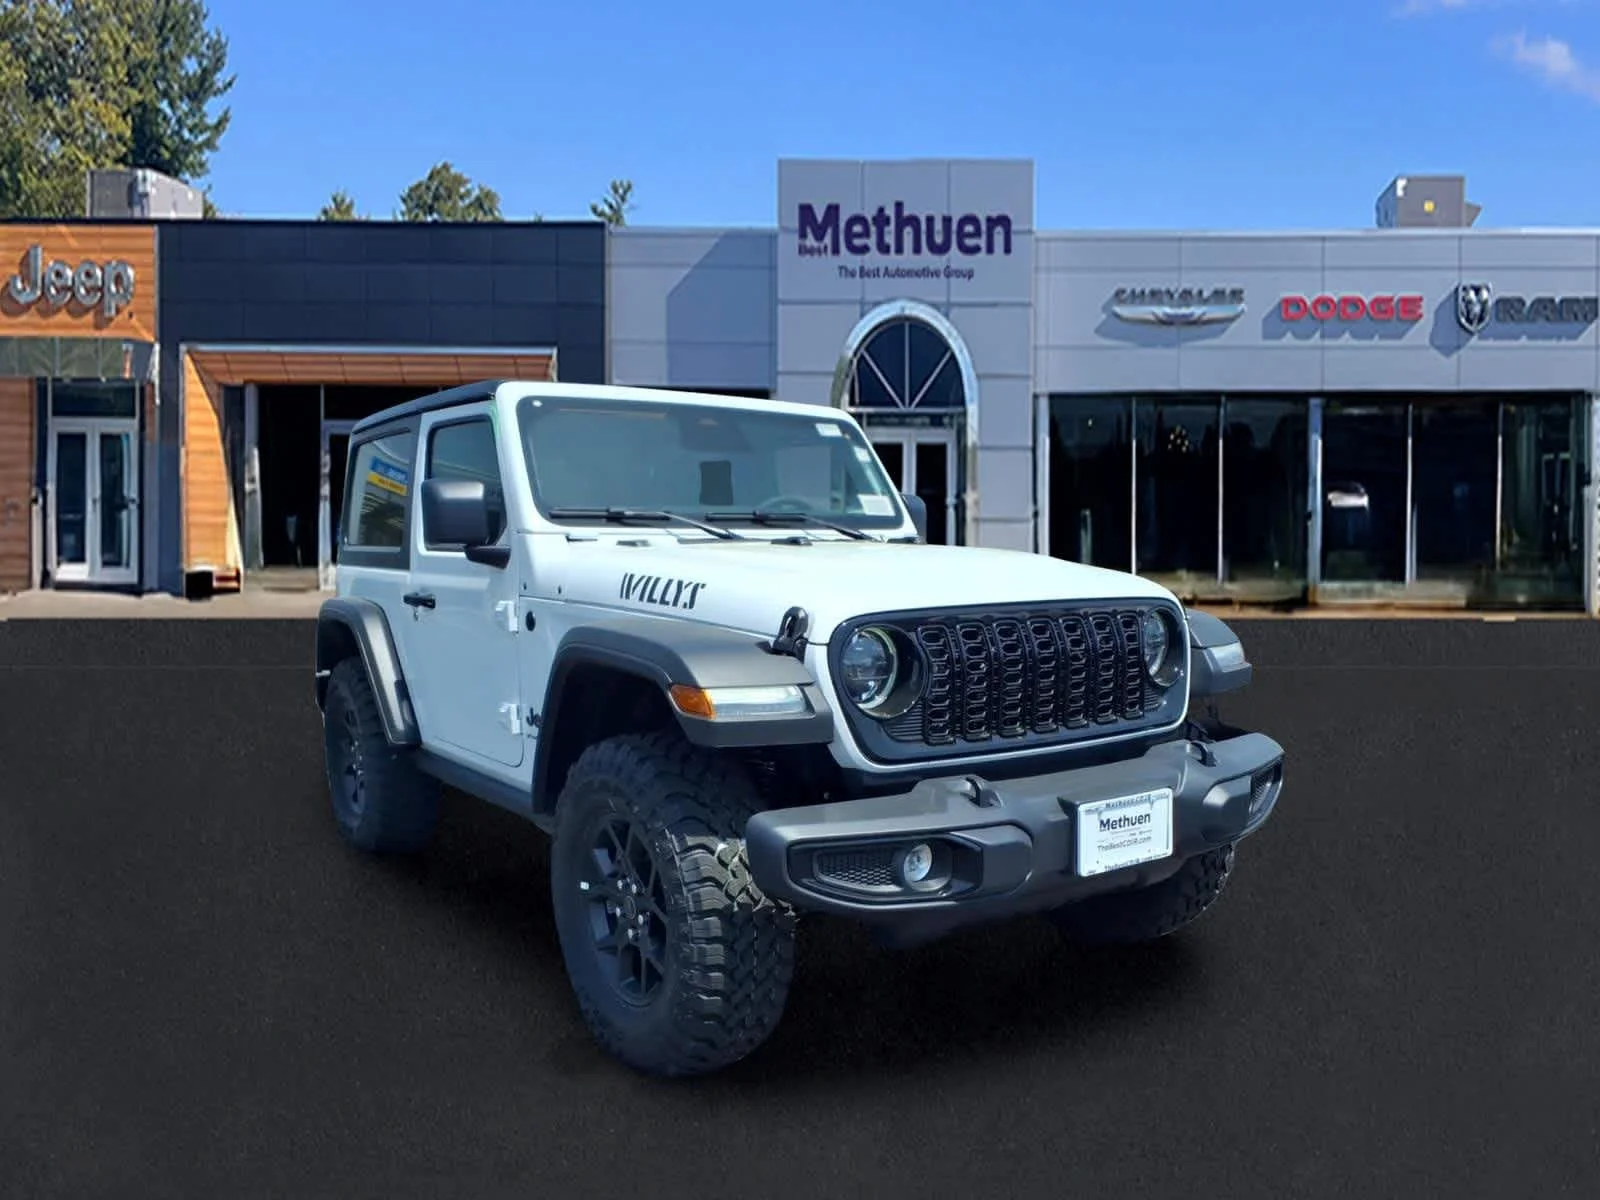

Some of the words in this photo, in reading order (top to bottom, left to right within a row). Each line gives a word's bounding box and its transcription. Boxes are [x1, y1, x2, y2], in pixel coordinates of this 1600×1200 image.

[798, 200, 1012, 256] Methuen
[9, 244, 135, 317] Jeep
[838, 265, 858, 278] The
[859, 265, 880, 279] Best
[883, 265, 941, 279] Automotive
[943, 264, 975, 281] Group
[1280, 295, 1424, 321] DODGE
[1495, 296, 1599, 323] RAM
[620, 572, 707, 609] WILLYS
[1099, 813, 1151, 830] Methuen
